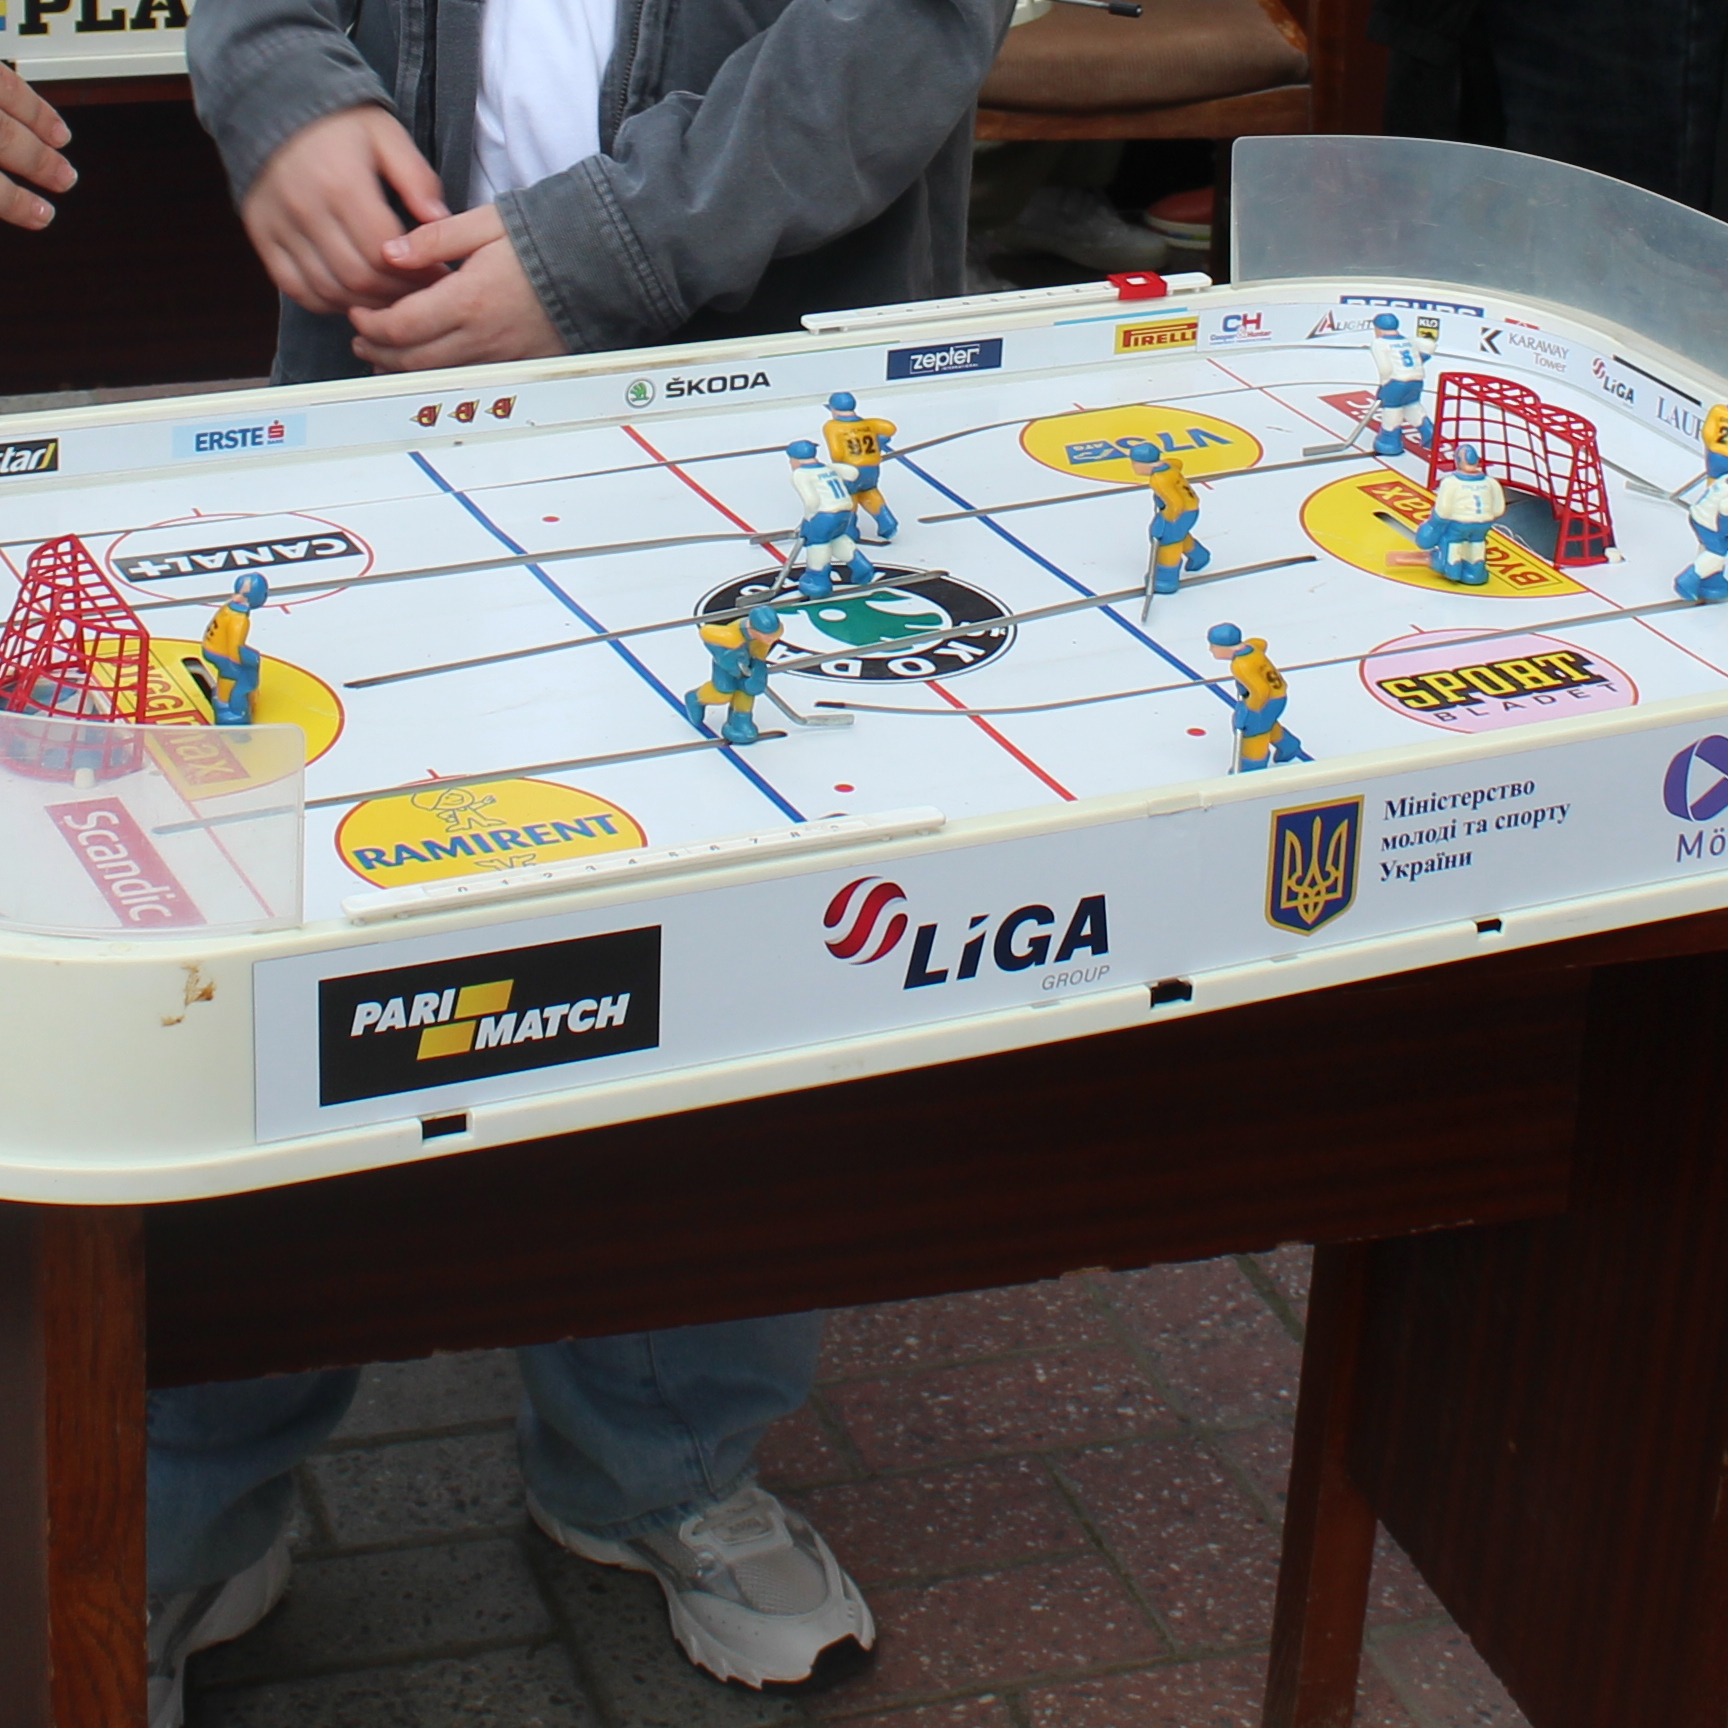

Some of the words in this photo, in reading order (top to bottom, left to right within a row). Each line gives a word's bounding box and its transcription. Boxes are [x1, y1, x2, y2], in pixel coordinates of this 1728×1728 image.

[910, 344, 980, 373] zepter
[1508, 333, 1569, 360] KARAWAY
[1533, 352, 1567, 373] Tower
[665, 372, 771, 399] ŠKODA
[195, 427, 264, 453] ERSTE
[129, 539, 348, 576] CANAL+
[1381, 651, 1589, 709] SPORT
[1433, 682, 1619, 722] BLADET
[1383, 779, 1536, 821] Міністерство
[351, 812, 620, 871] RAMIRENT
[1381, 818, 1458, 853] молоді
[1463, 818, 1488, 836] та
[1495, 803, 1571, 829] спорту
[63, 810, 177, 922] Scandic
[1379, 850, 1473, 882] України
[1042, 965, 1110, 990] GROUP
[350, 988, 455, 1037] PARI
[474, 993, 631, 1051] MATCH
